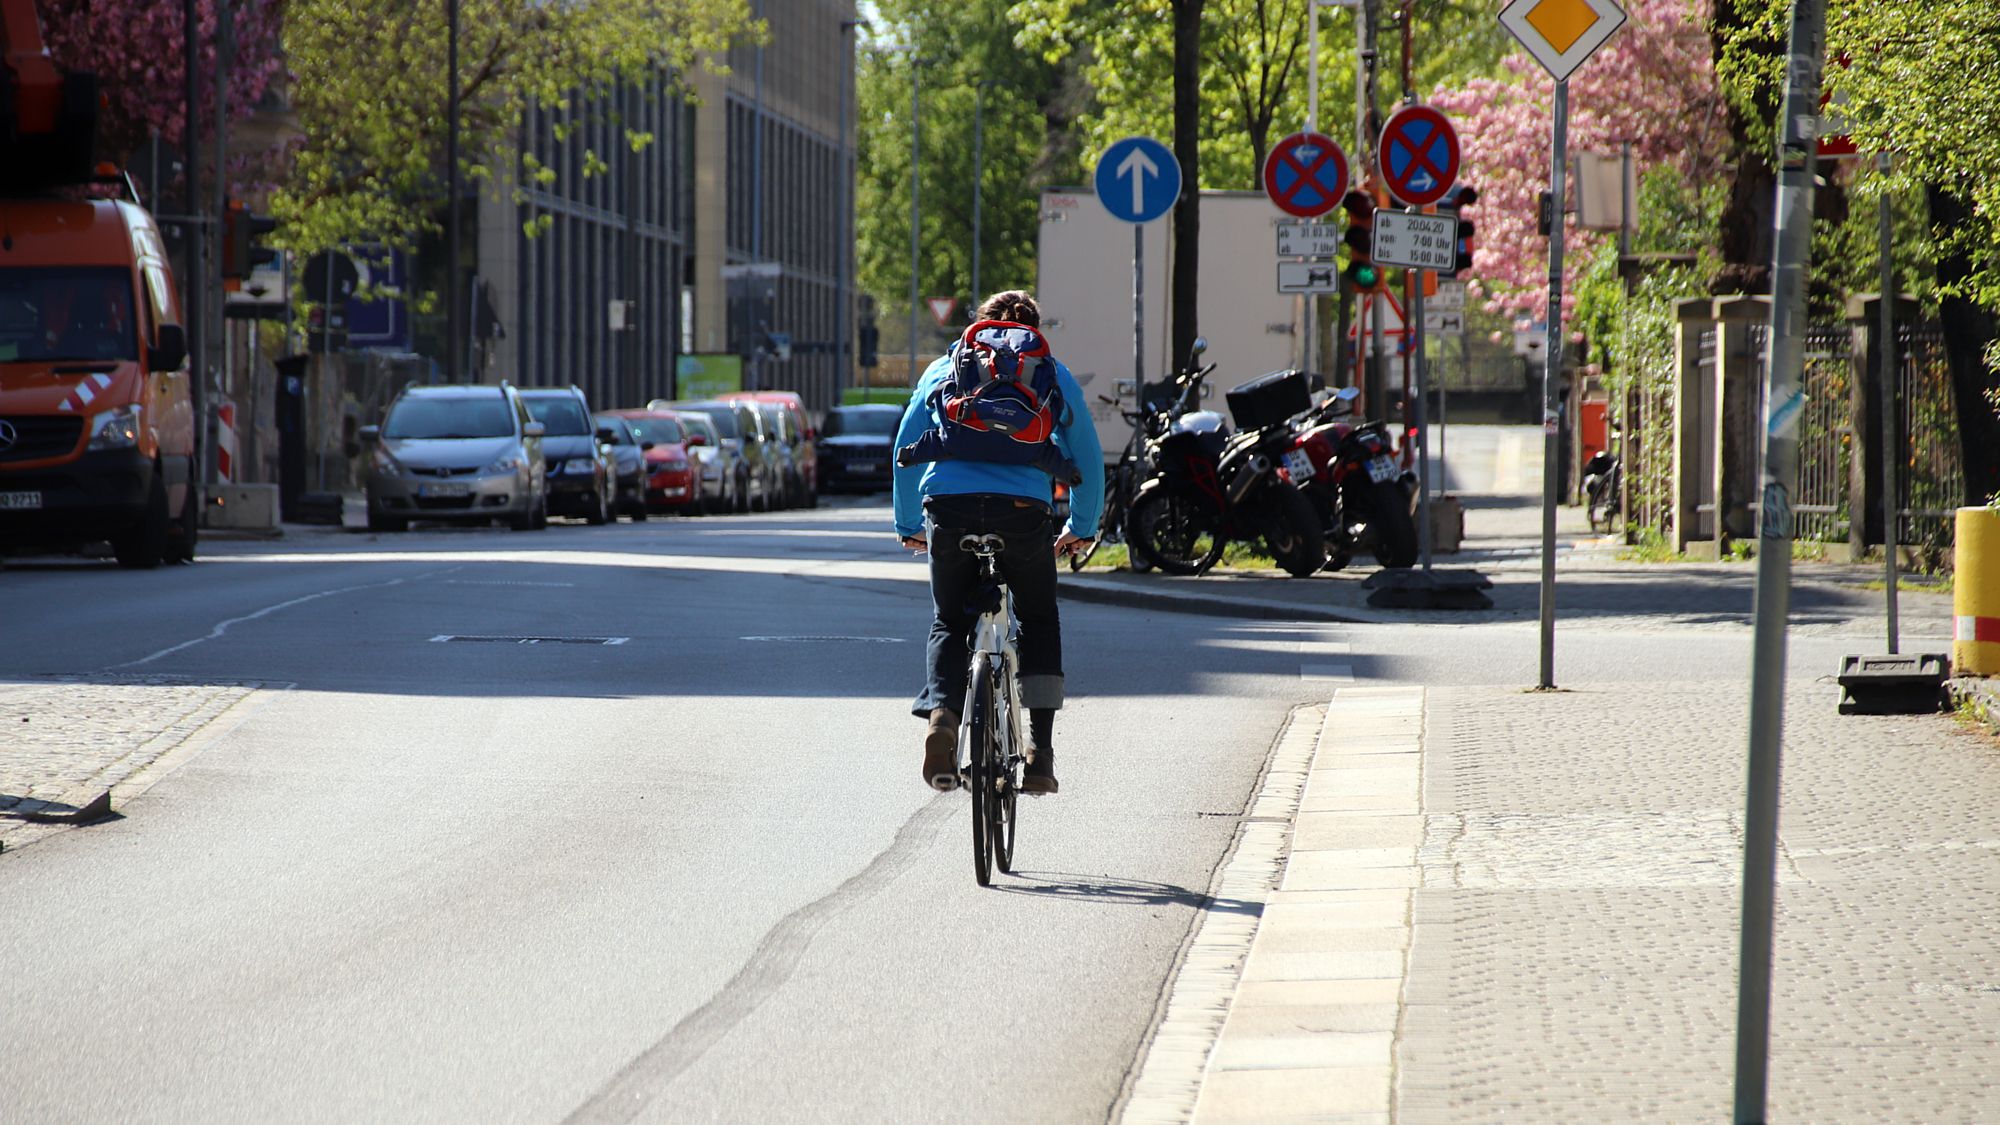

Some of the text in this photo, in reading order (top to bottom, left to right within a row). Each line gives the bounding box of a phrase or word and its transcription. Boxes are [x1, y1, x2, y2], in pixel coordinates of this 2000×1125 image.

[1407, 218, 1444, 234] 20.04.20
[1280, 228, 1290, 238] ab
[1281, 243, 1291, 253] ab
[1312, 242, 1318, 253] 7
[1380, 234, 1397, 244] von:
[1436, 237, 1451, 249] Uhr
[1378, 246, 1450, 264] bis: 15:00 Uhr
[11, 494, 39, 505] 9711
